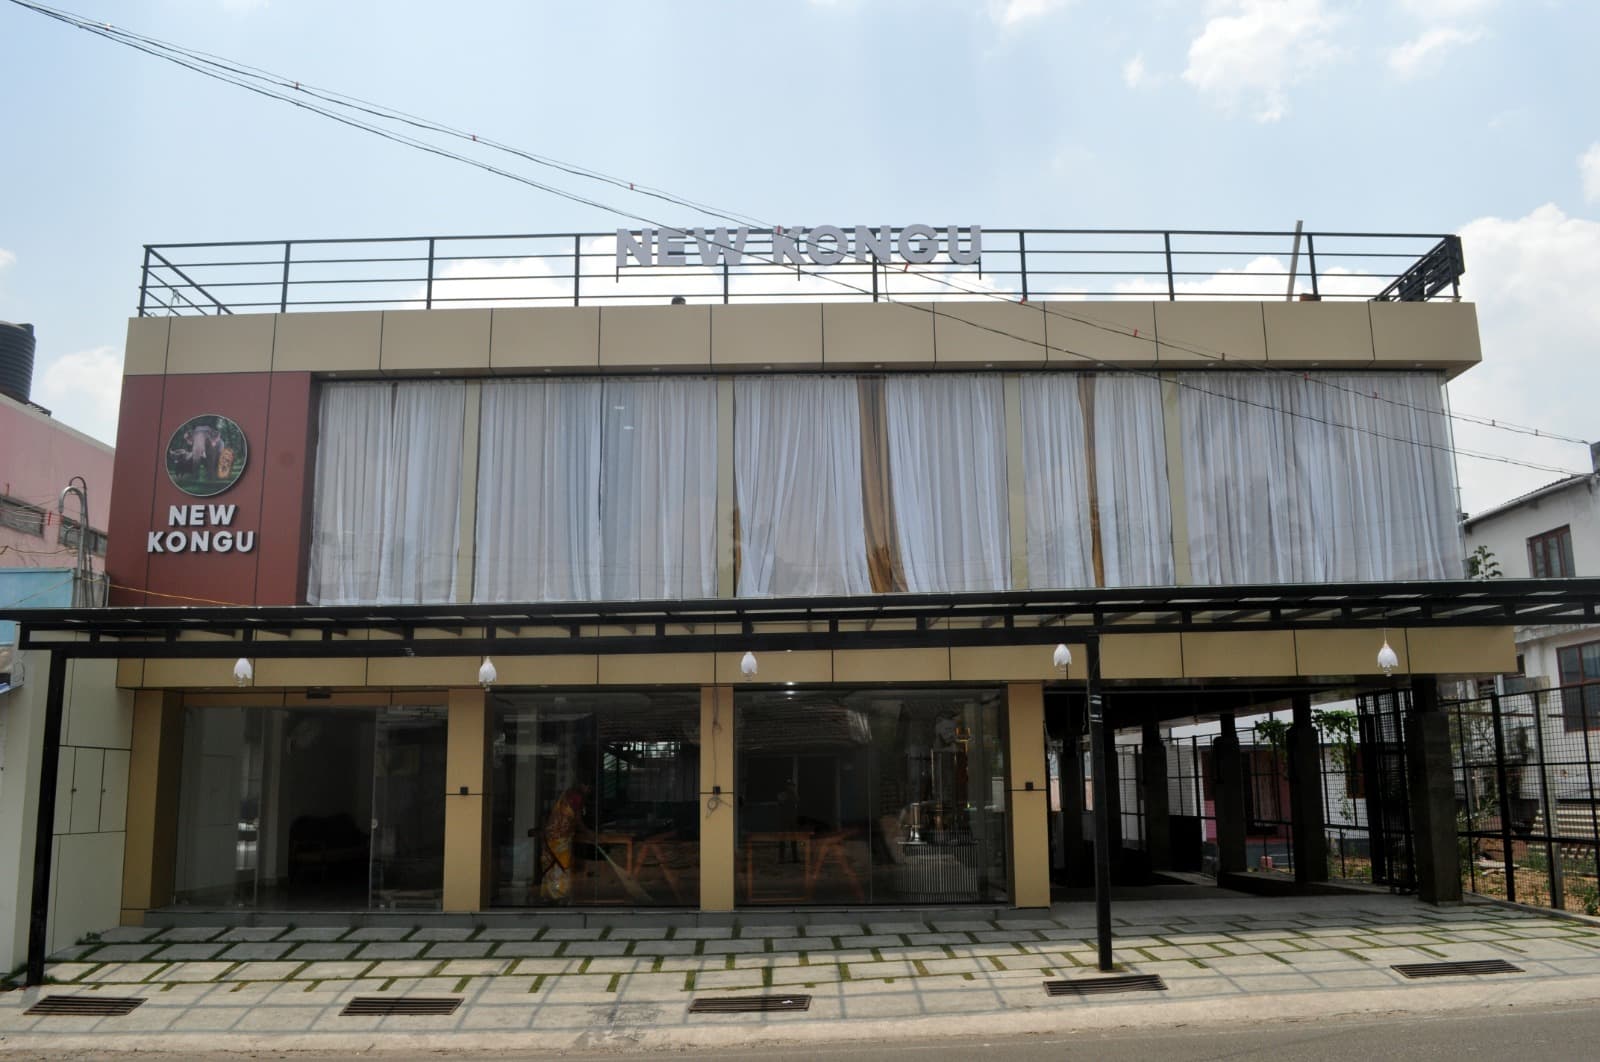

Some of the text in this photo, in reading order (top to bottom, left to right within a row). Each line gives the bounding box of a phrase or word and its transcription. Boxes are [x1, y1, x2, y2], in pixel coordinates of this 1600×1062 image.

[616, 224, 982, 267] NEW KONGU
[168, 503, 236, 526] NEW
[147, 530, 254, 553] KONGU
